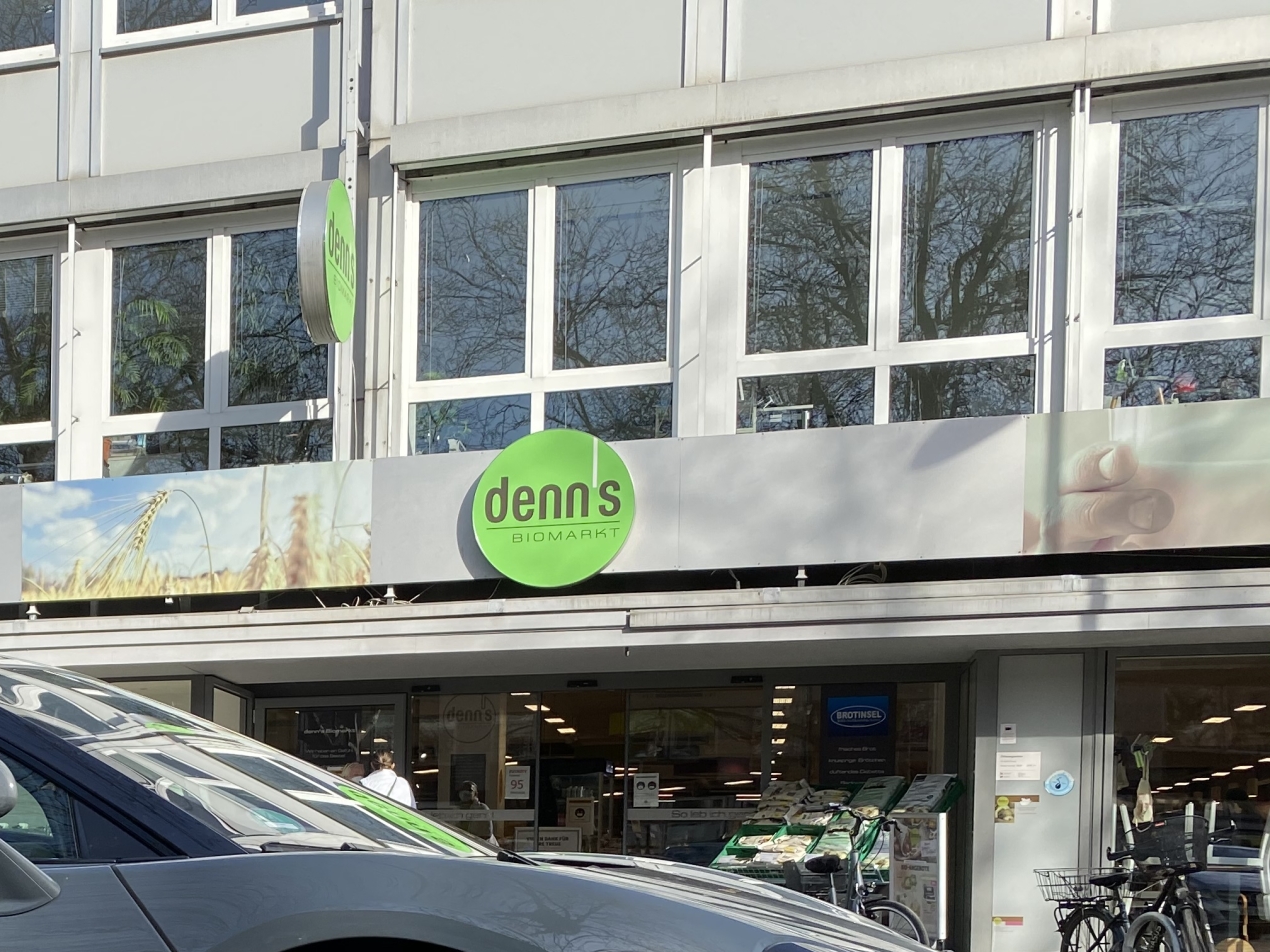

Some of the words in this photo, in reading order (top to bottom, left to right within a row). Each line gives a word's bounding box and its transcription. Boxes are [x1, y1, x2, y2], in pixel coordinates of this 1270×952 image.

[485, 477, 621, 524] denn's
[512, 528, 621, 544] BIOMARKT
[836, 710, 882, 720] BROTINSEL
[510, 779, 524, 790] 95
